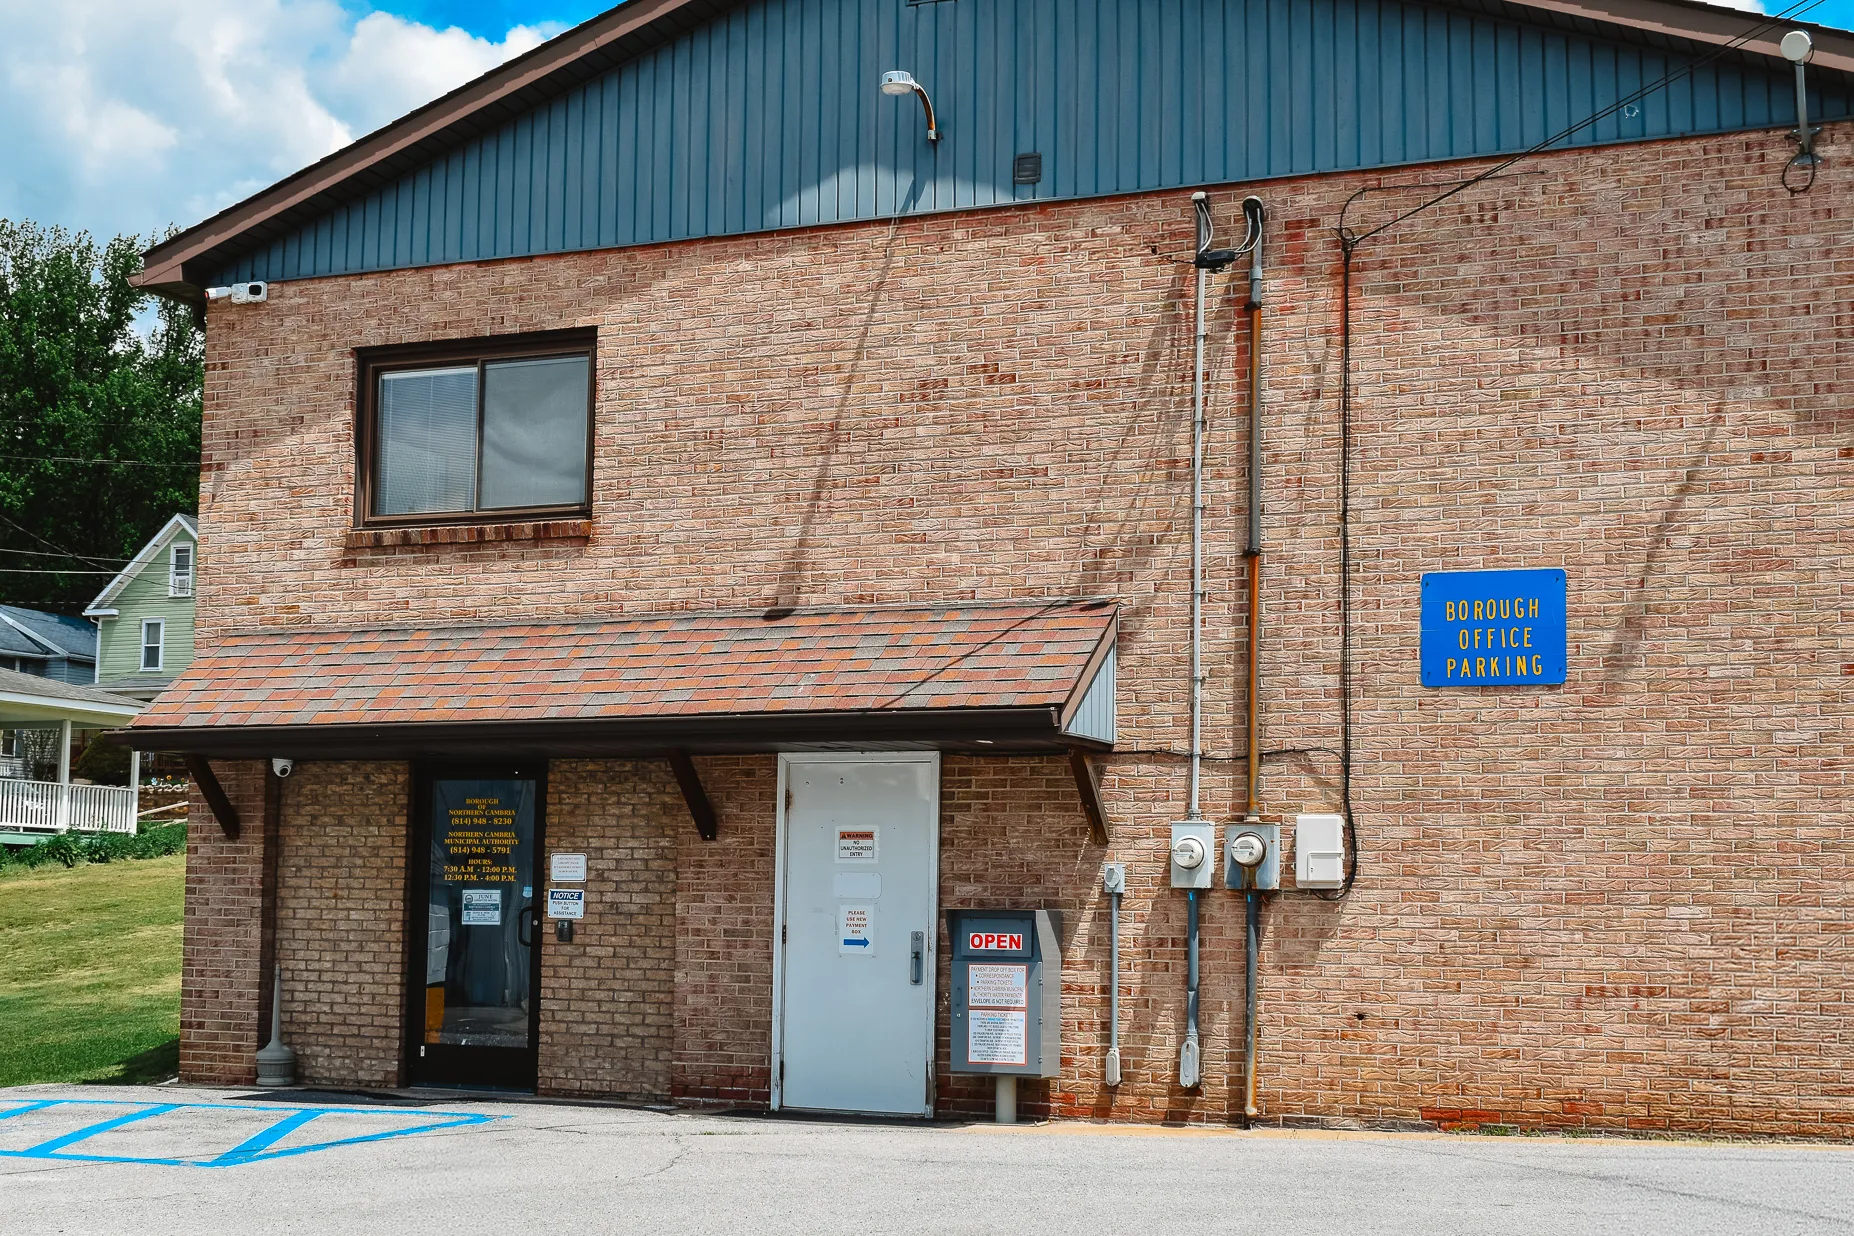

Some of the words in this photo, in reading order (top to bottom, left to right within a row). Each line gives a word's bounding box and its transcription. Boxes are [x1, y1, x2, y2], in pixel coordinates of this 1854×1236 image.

[1446, 598, 1539, 621] BOROUGH
[1459, 627, 1532, 649] OFFICE
[1447, 655, 1542, 678] PARKING
[971, 934, 1021, 949] OPEN
